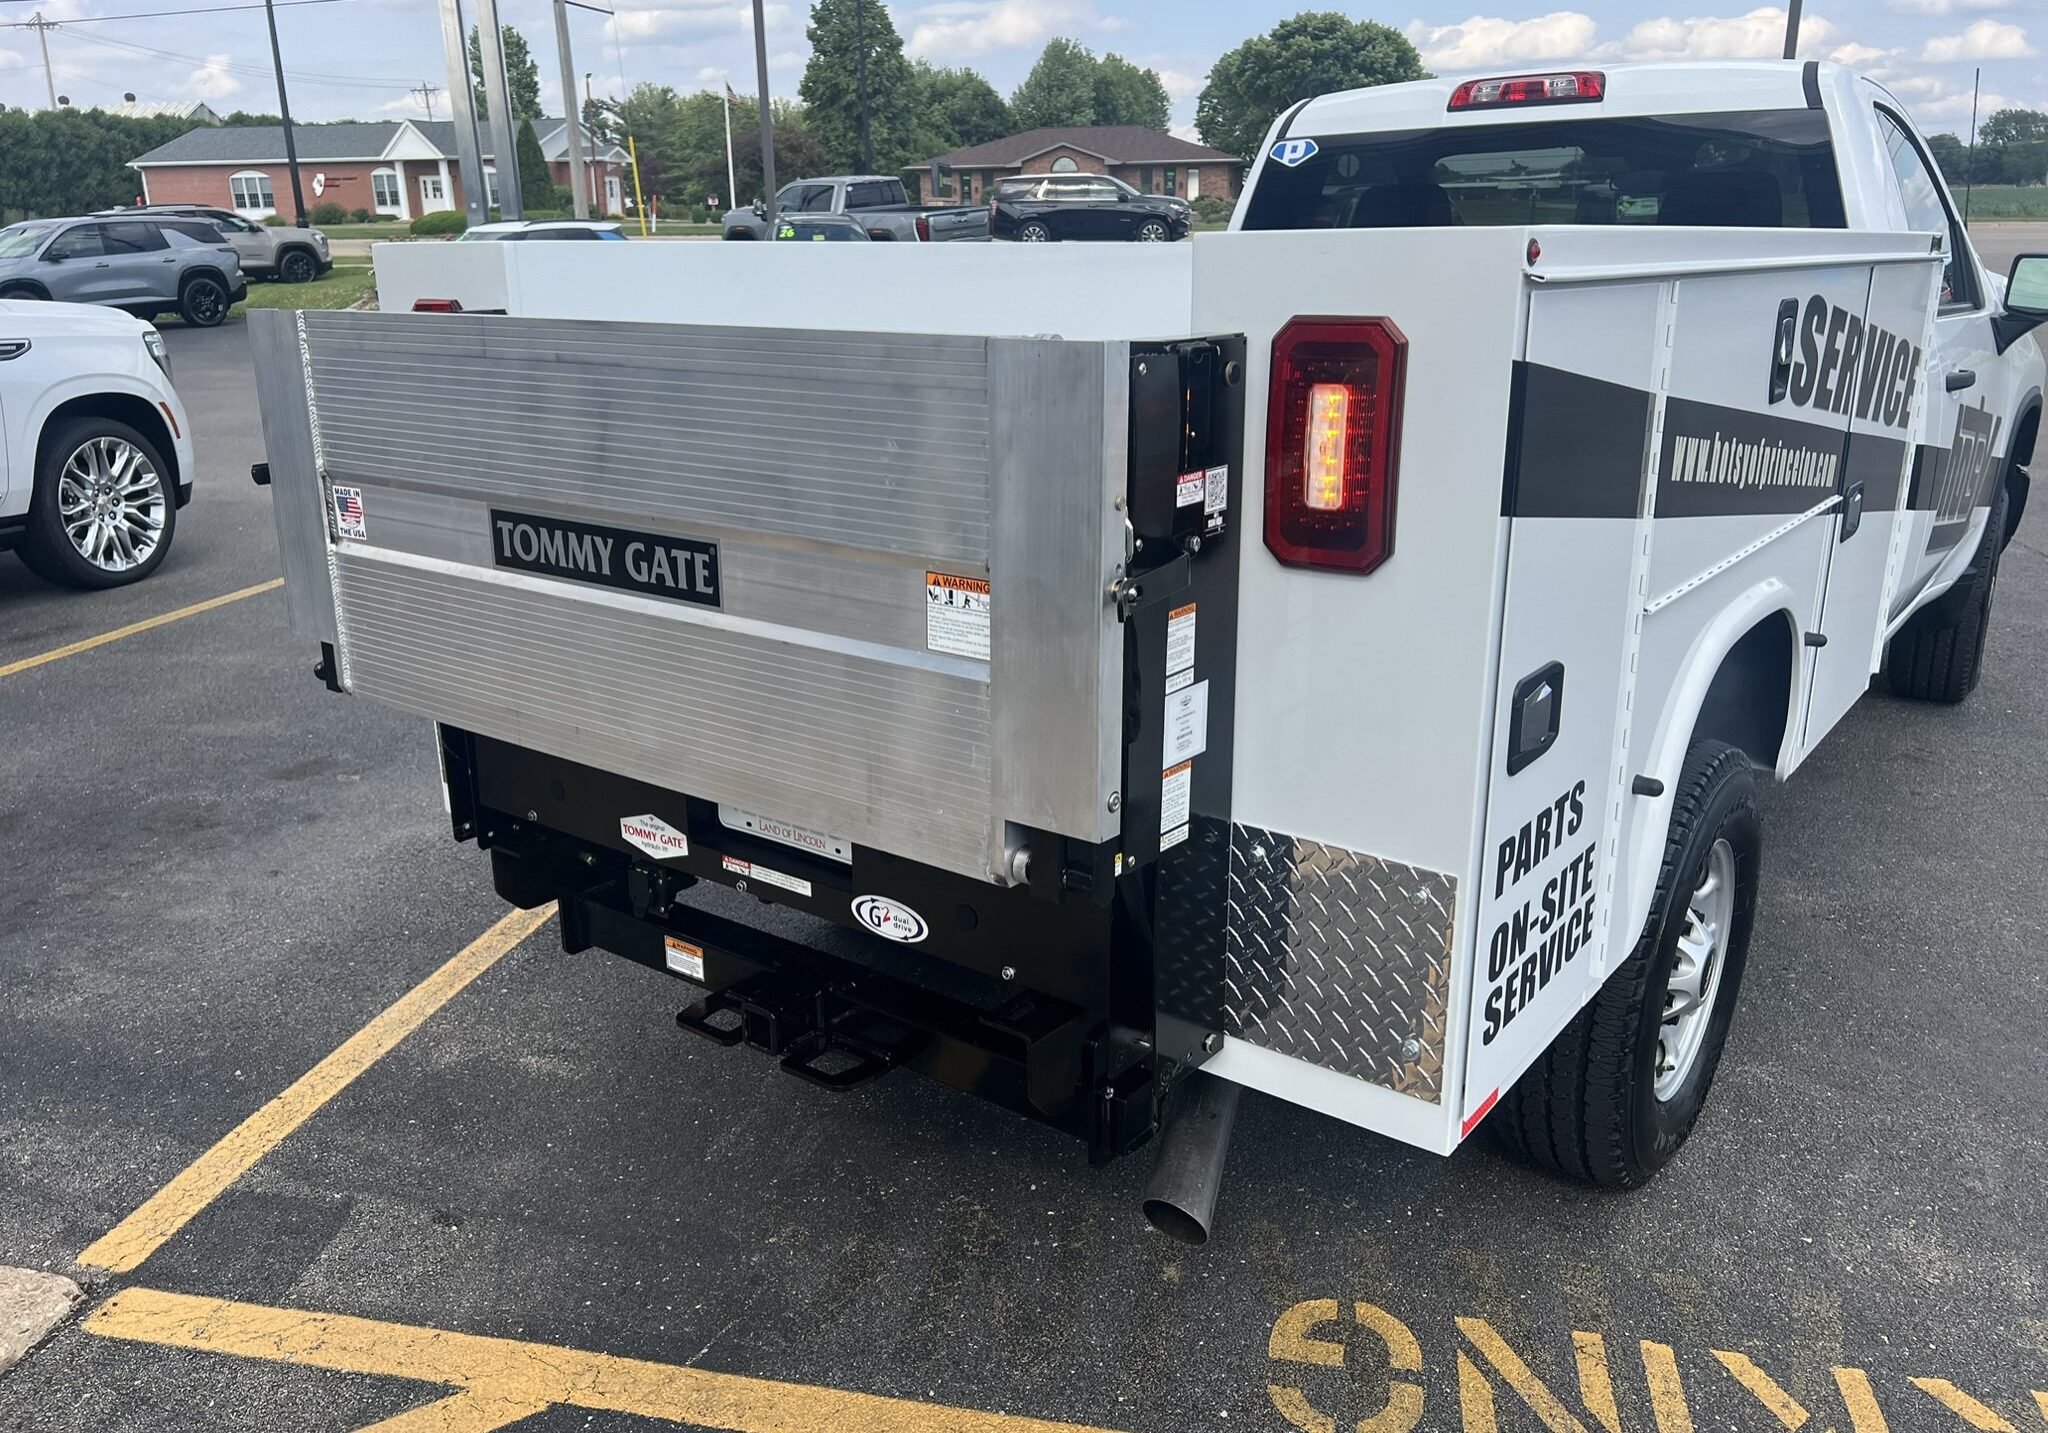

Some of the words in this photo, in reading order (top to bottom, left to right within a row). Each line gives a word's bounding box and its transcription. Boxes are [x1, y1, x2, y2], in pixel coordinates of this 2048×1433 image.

[779, 228, 795, 238] 26
[1790, 294, 1922, 429] SERVICE
[1671, 431, 1838, 490] www.hotsyofprinceton.com
[335, 488, 351, 496] MADE
[340, 527, 352, 536] THE
[353, 530, 366, 538] USA
[496, 520, 614, 576] TOMMY
[624, 541, 714, 595] GATE
[942, 576, 991, 594] WARNING
[623, 823, 657, 842] TOMMY
[660, 834, 684, 849] GATE
[759, 819, 781, 836] LAND
[793, 829, 826, 850] LINCOLN
[1494, 780, 1585, 900] PARTS
[893, 914, 909, 925] dual
[1488, 841, 1596, 983] ON-SITE
[893, 922, 912, 934] drive
[1482, 893, 1596, 1046] SERVICE
